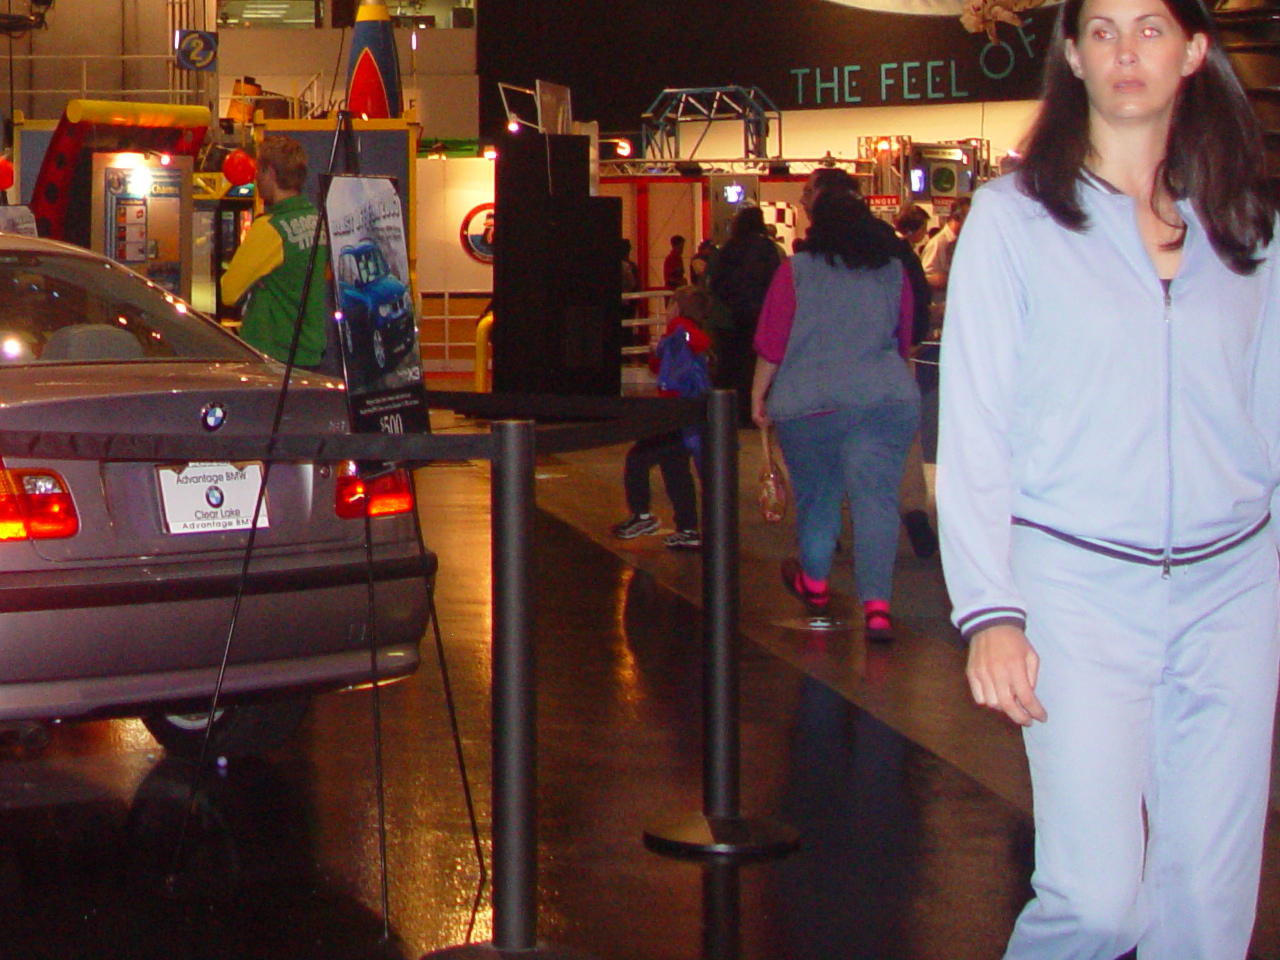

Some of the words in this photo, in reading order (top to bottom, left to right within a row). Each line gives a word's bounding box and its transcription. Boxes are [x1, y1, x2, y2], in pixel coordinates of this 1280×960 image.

[190, 39, 204, 60] 2
[790, 64, 861, 104] THE
[881, 60, 969, 101] FEEL
[176, 473, 224, 485] Advantage
[225, 471, 247, 481] BMW
[194, 509, 219, 520] Clear
[221, 508, 241, 518] Lake
[182, 520, 233, 529] Advantage
